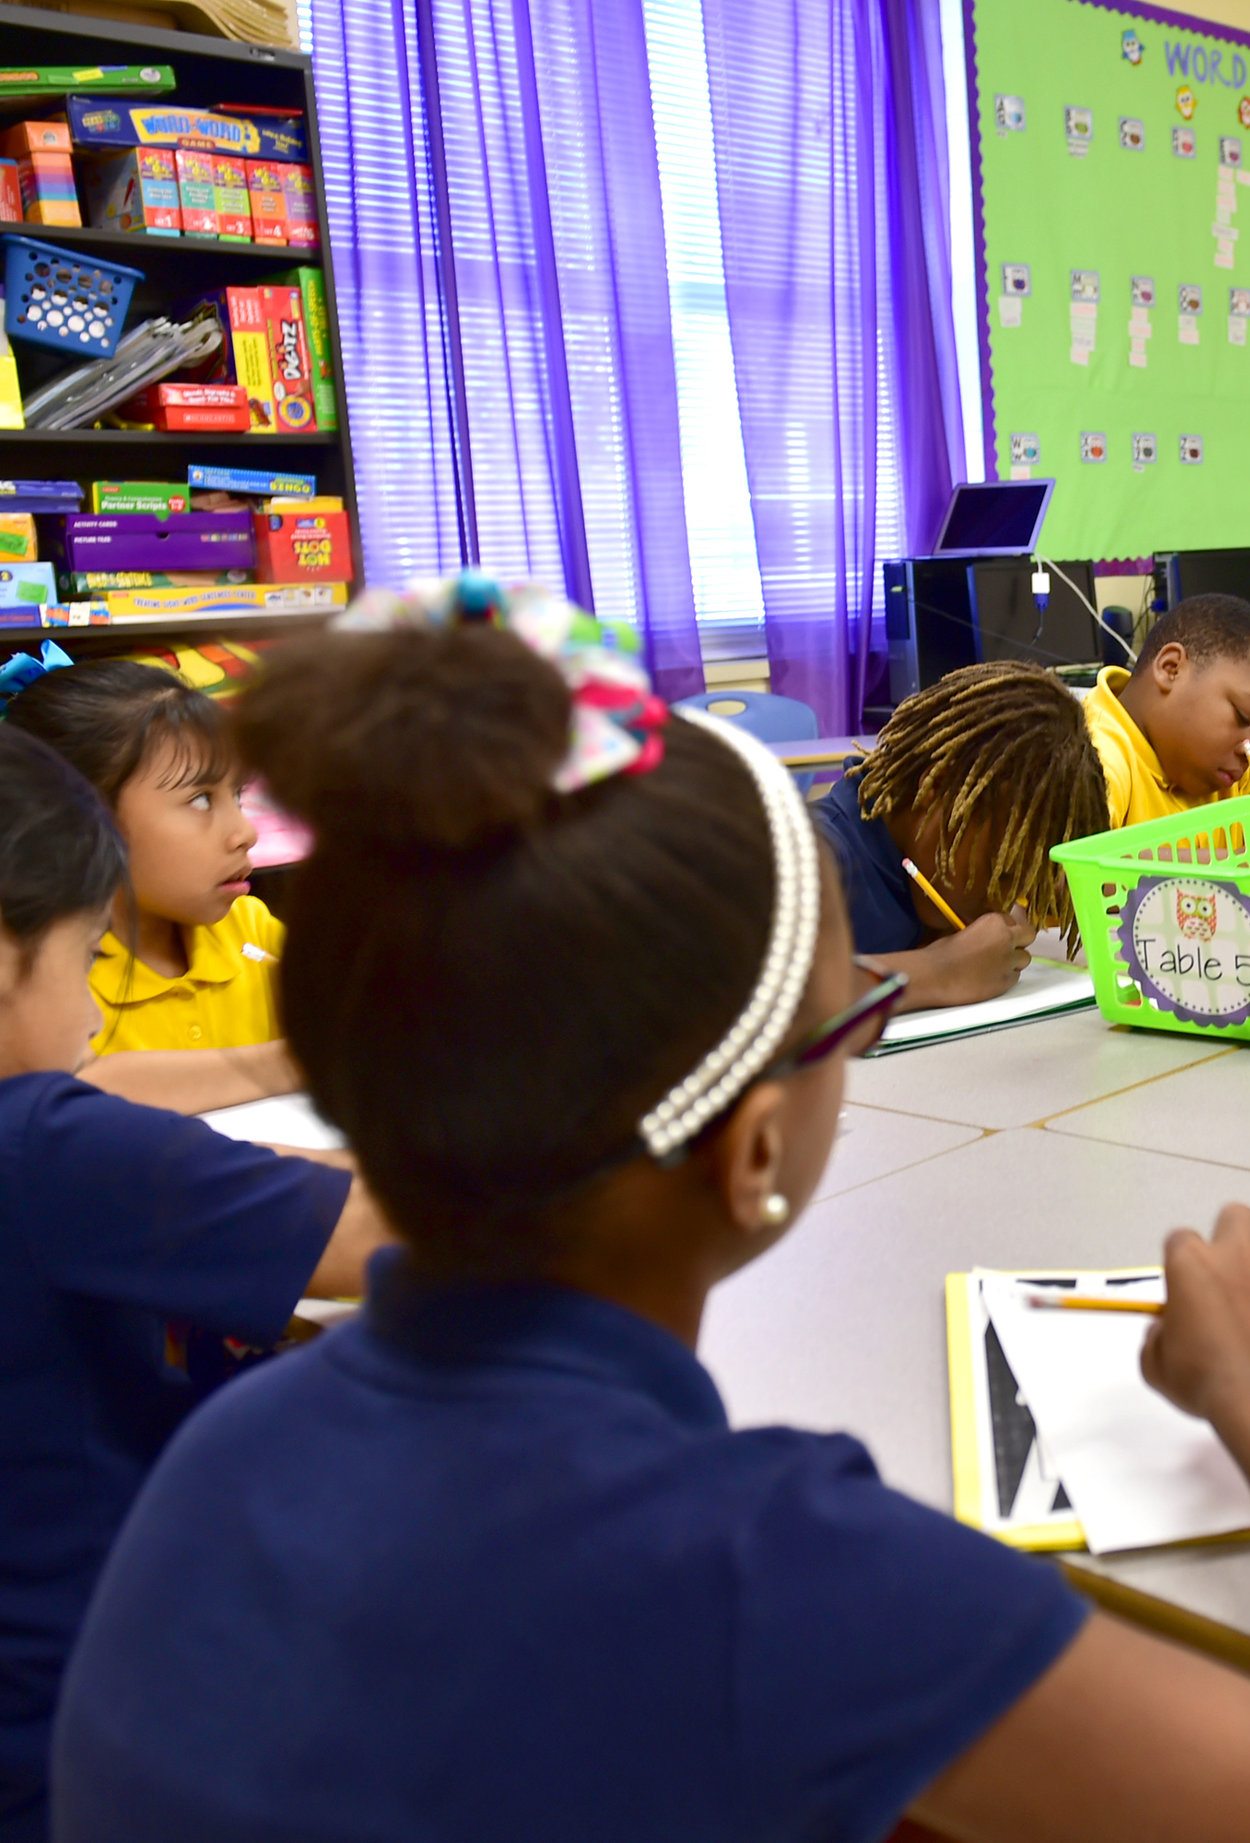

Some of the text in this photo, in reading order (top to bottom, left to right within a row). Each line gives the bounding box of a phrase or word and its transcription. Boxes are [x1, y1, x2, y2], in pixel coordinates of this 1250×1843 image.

[1165, 41, 1247, 89] WORD
[270, 480, 310, 493] BINGO
[101, 501, 135, 510] Partner
[136, 501, 167, 512] Scripts
[1136, 938, 1222, 981] Table
